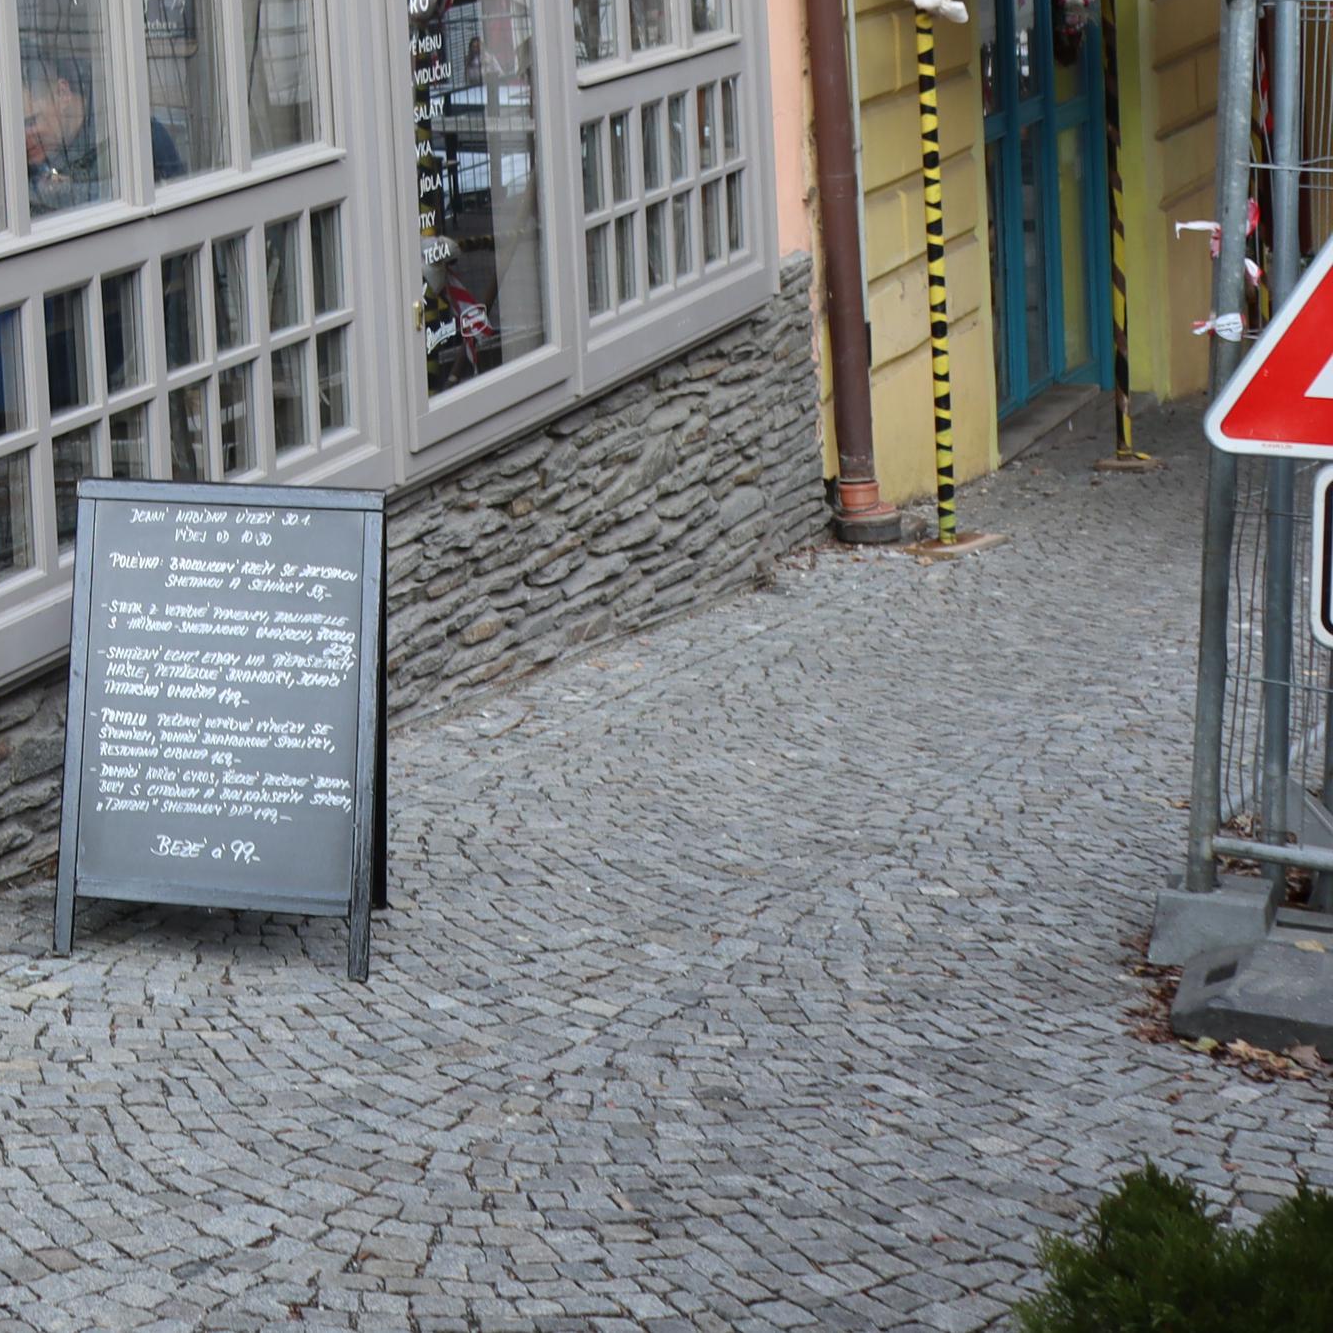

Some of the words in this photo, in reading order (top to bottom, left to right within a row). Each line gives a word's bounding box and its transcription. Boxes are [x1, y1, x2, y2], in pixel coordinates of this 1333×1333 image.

[418, 33, 443, 53] MENU
[414, 61, 452, 86] VIDLIČKU
[413, 96, 445, 124] SALÁTY
[420, 173, 442, 198] JÍDLA
[423, 242, 450, 265] TEČKA
